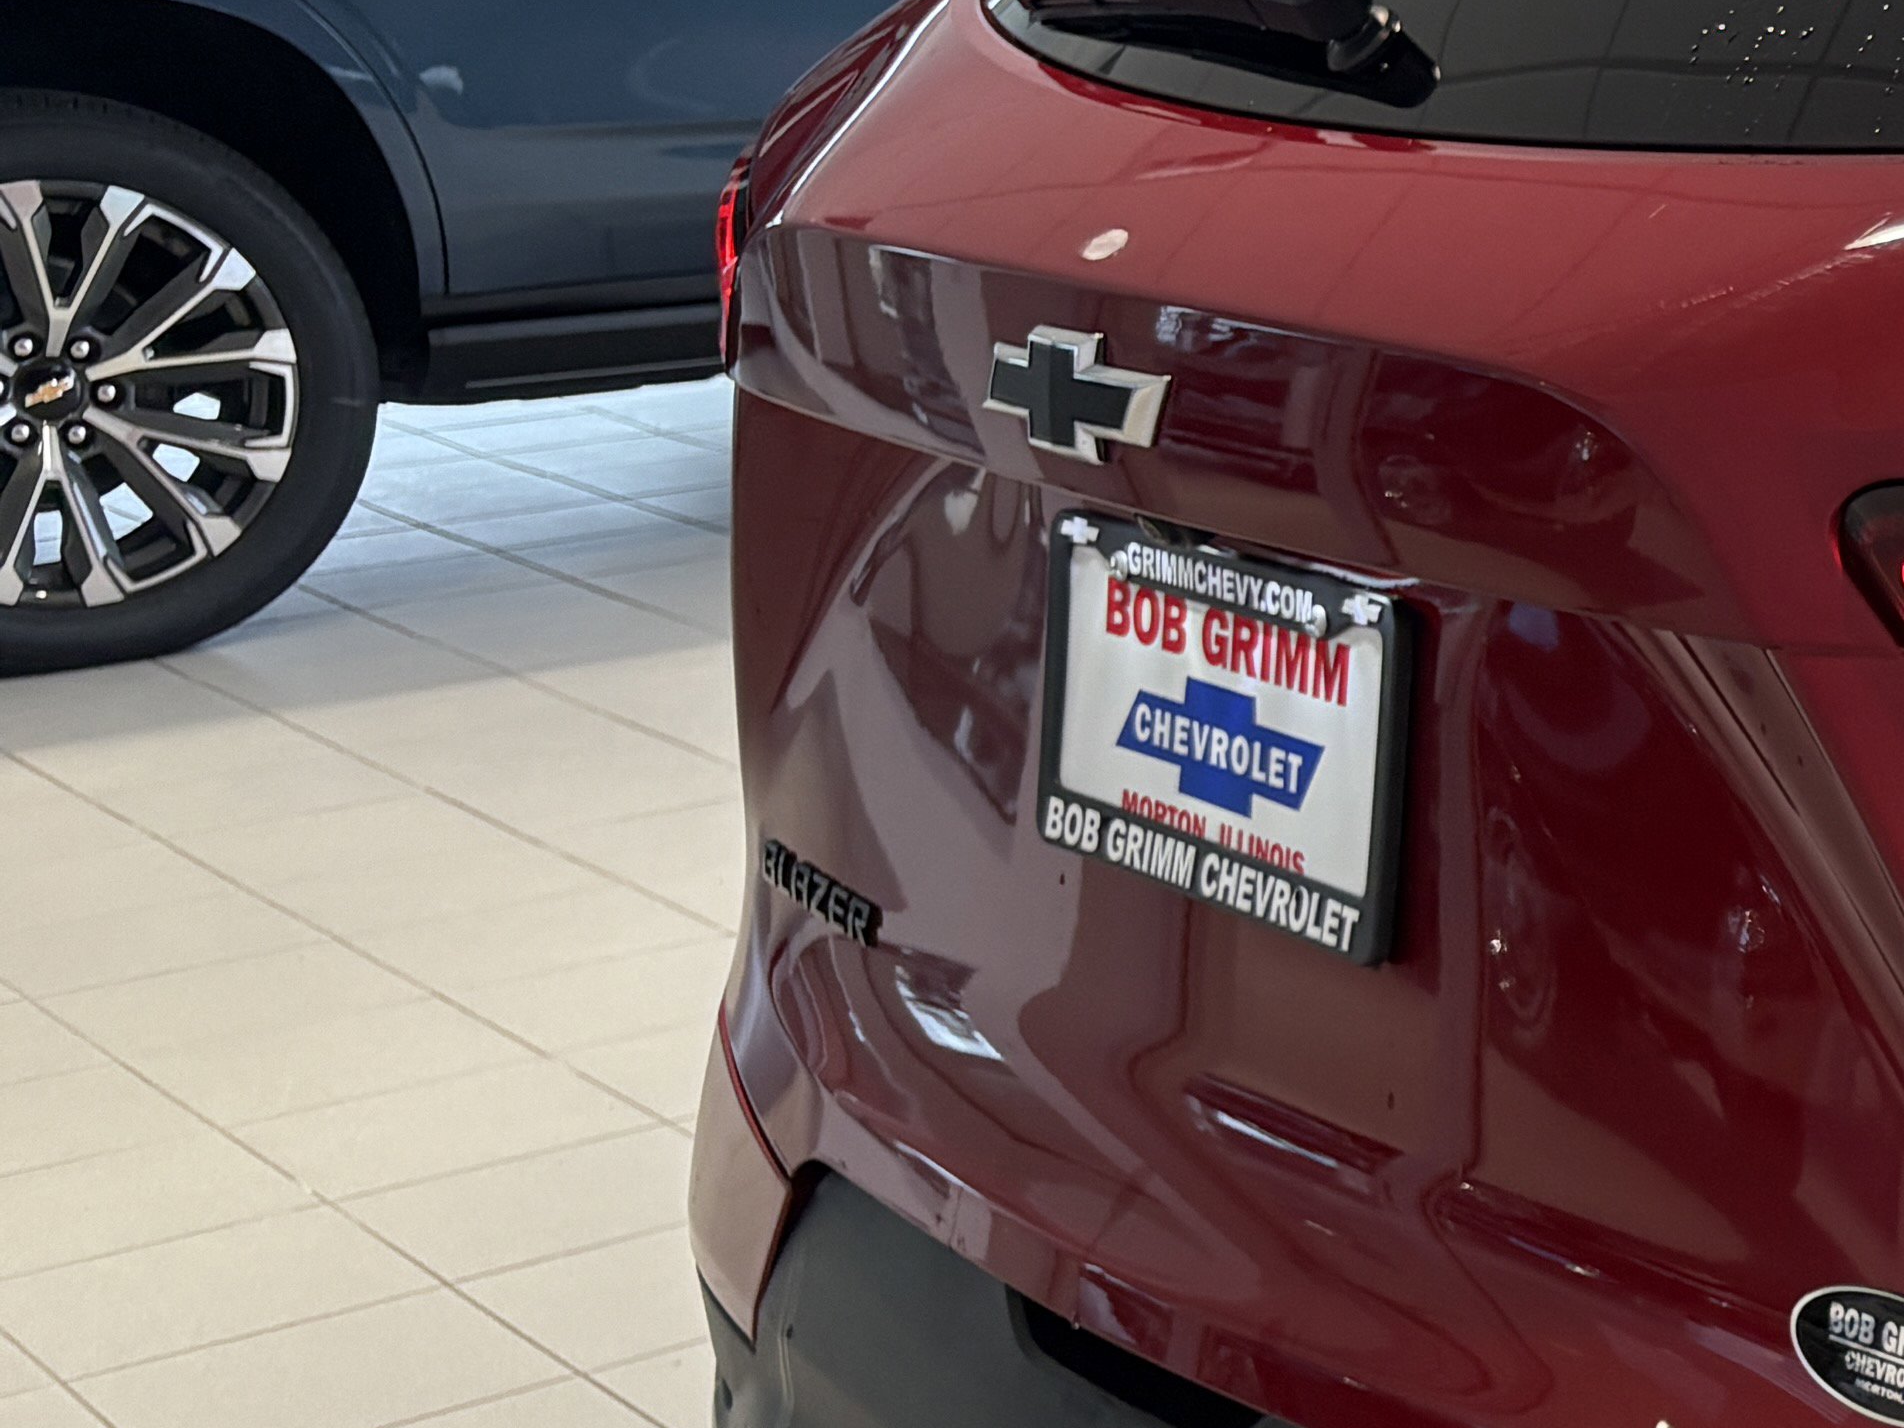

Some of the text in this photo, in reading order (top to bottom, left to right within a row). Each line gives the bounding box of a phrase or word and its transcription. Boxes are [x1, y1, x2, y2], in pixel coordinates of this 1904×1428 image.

[1126, 541, 1313, 622] GRIMMCHEVY.COM
[1105, 575, 1350, 707] BOB GRIMM
[1133, 703, 1304, 794] CHEVROLET
[763, 838, 882, 948] BLAZER
[1044, 795, 1361, 953] BOB GRIMM CHEVROLET
[1828, 1301, 1876, 1346] BOB
